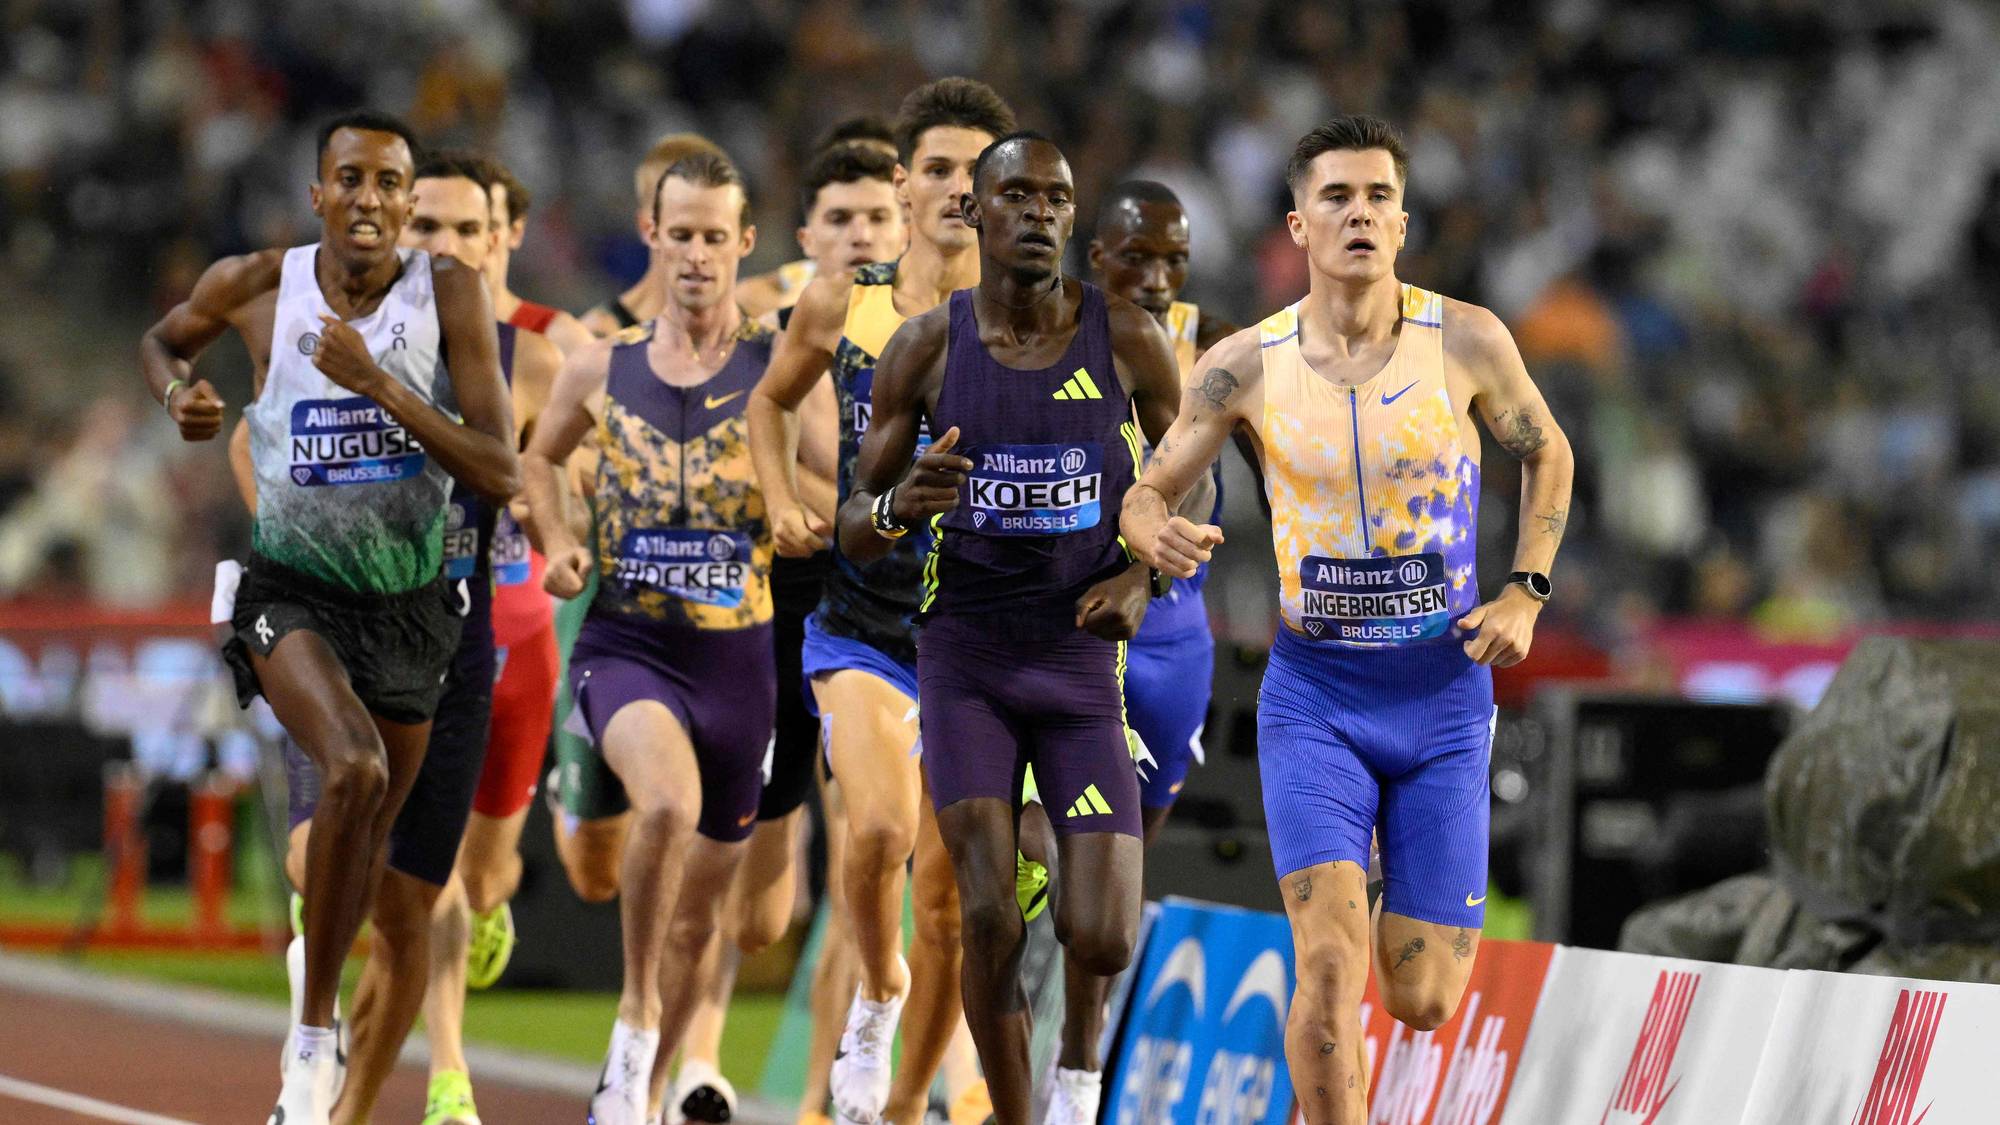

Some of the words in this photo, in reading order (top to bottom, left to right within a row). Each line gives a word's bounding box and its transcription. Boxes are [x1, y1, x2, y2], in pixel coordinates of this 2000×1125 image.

[305, 407, 377, 428] Allianz
[327, 465, 403, 482] BRUSSELS
[982, 453, 1056, 474] Allianz
[971, 476, 1098, 508] KOECH
[1002, 514, 1078, 530] BRUSSELS
[634, 536, 704, 557] Allianz
[623, 563, 742, 588] HOCKER
[1316, 564, 1394, 585] Allianz
[1304, 587, 1447, 617] INGEBRIGTSEN
[1341, 624, 1421, 639] BRUSSELS
[1614, 970, 1701, 1115] RUN
[1858, 989, 1948, 1125] RUN
